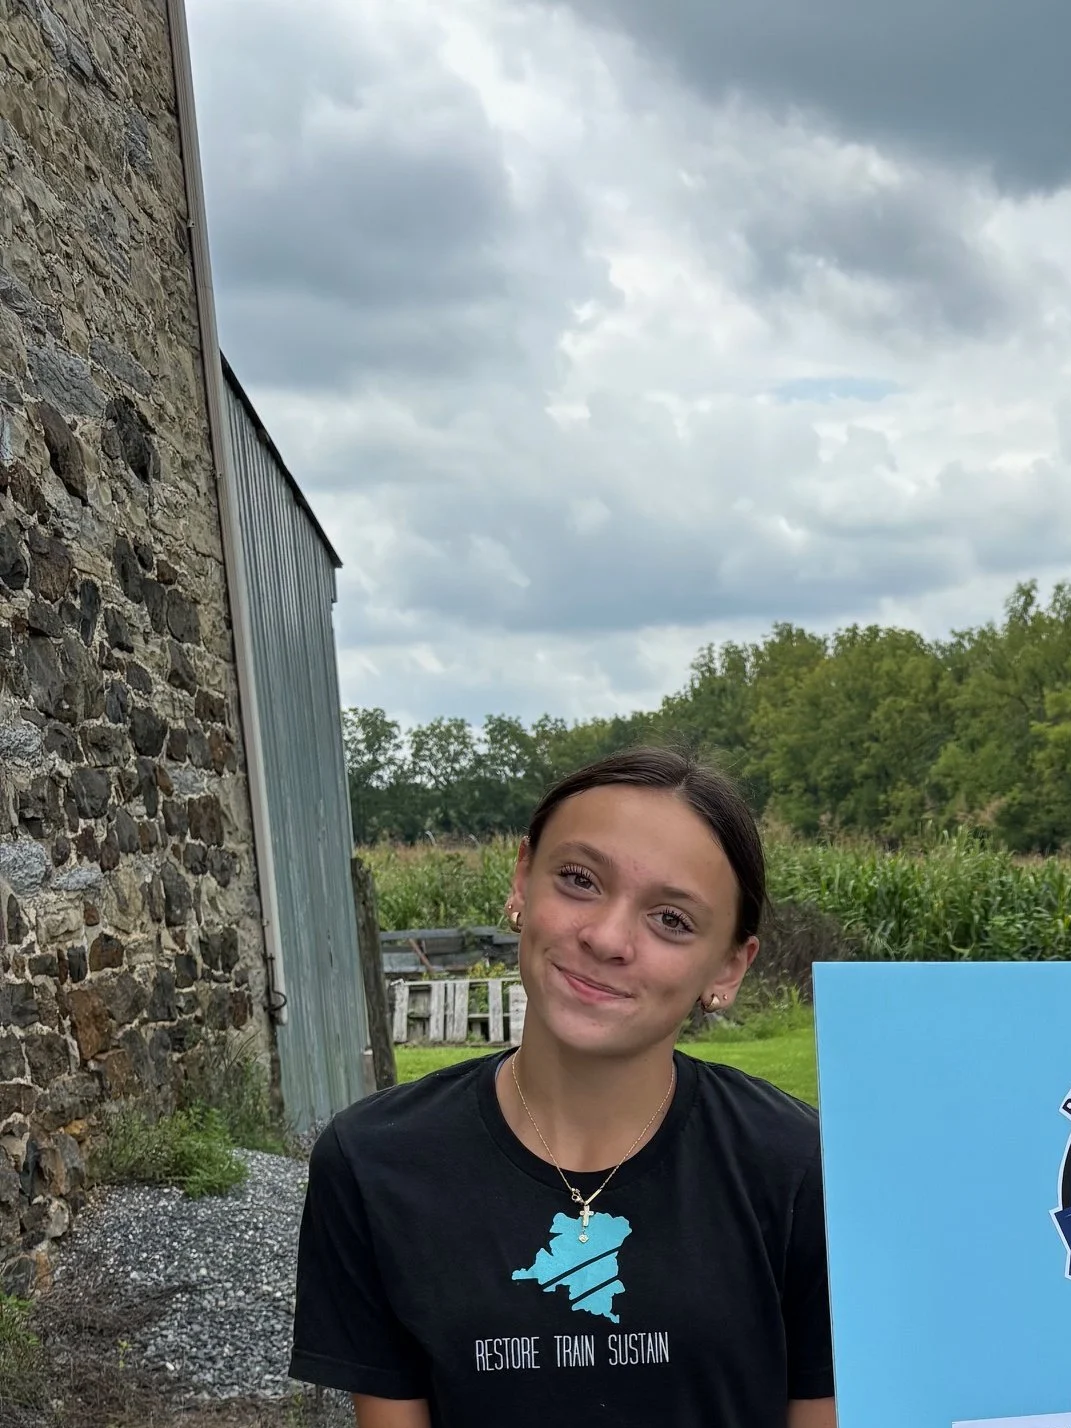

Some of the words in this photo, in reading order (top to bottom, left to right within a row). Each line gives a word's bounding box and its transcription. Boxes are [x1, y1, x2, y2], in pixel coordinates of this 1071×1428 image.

[476, 1337, 540, 1371] RESTORE
[554, 1335, 594, 1367] TRAIN
[609, 1332, 669, 1365] SUSTAIN
